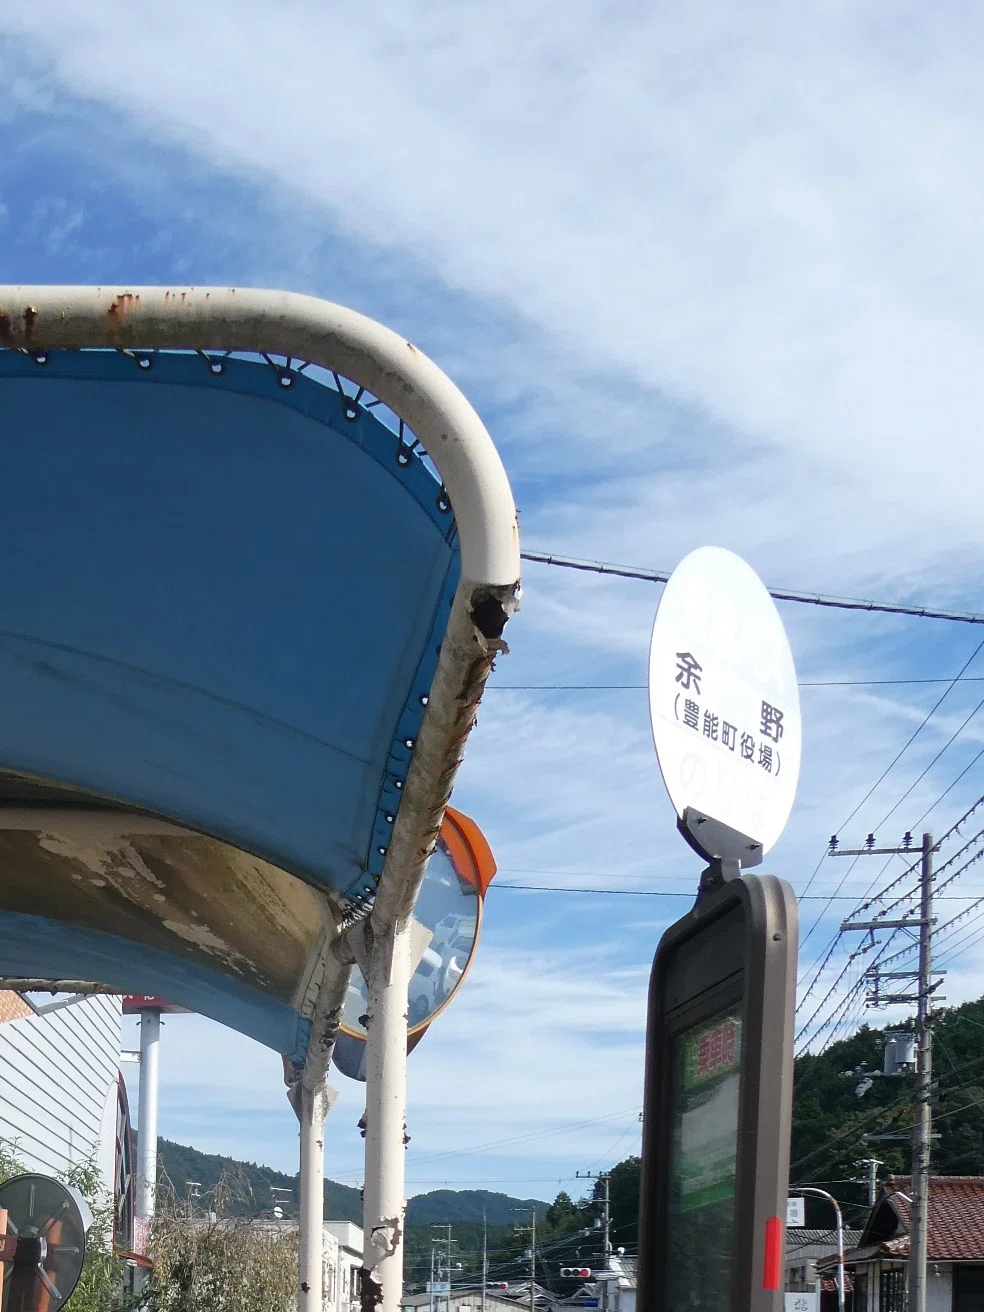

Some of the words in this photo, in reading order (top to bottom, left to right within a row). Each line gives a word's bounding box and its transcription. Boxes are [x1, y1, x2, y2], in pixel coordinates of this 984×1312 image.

[674, 693, 781, 777] (豊能町役場)
[675, 651, 785, 745] 余野
